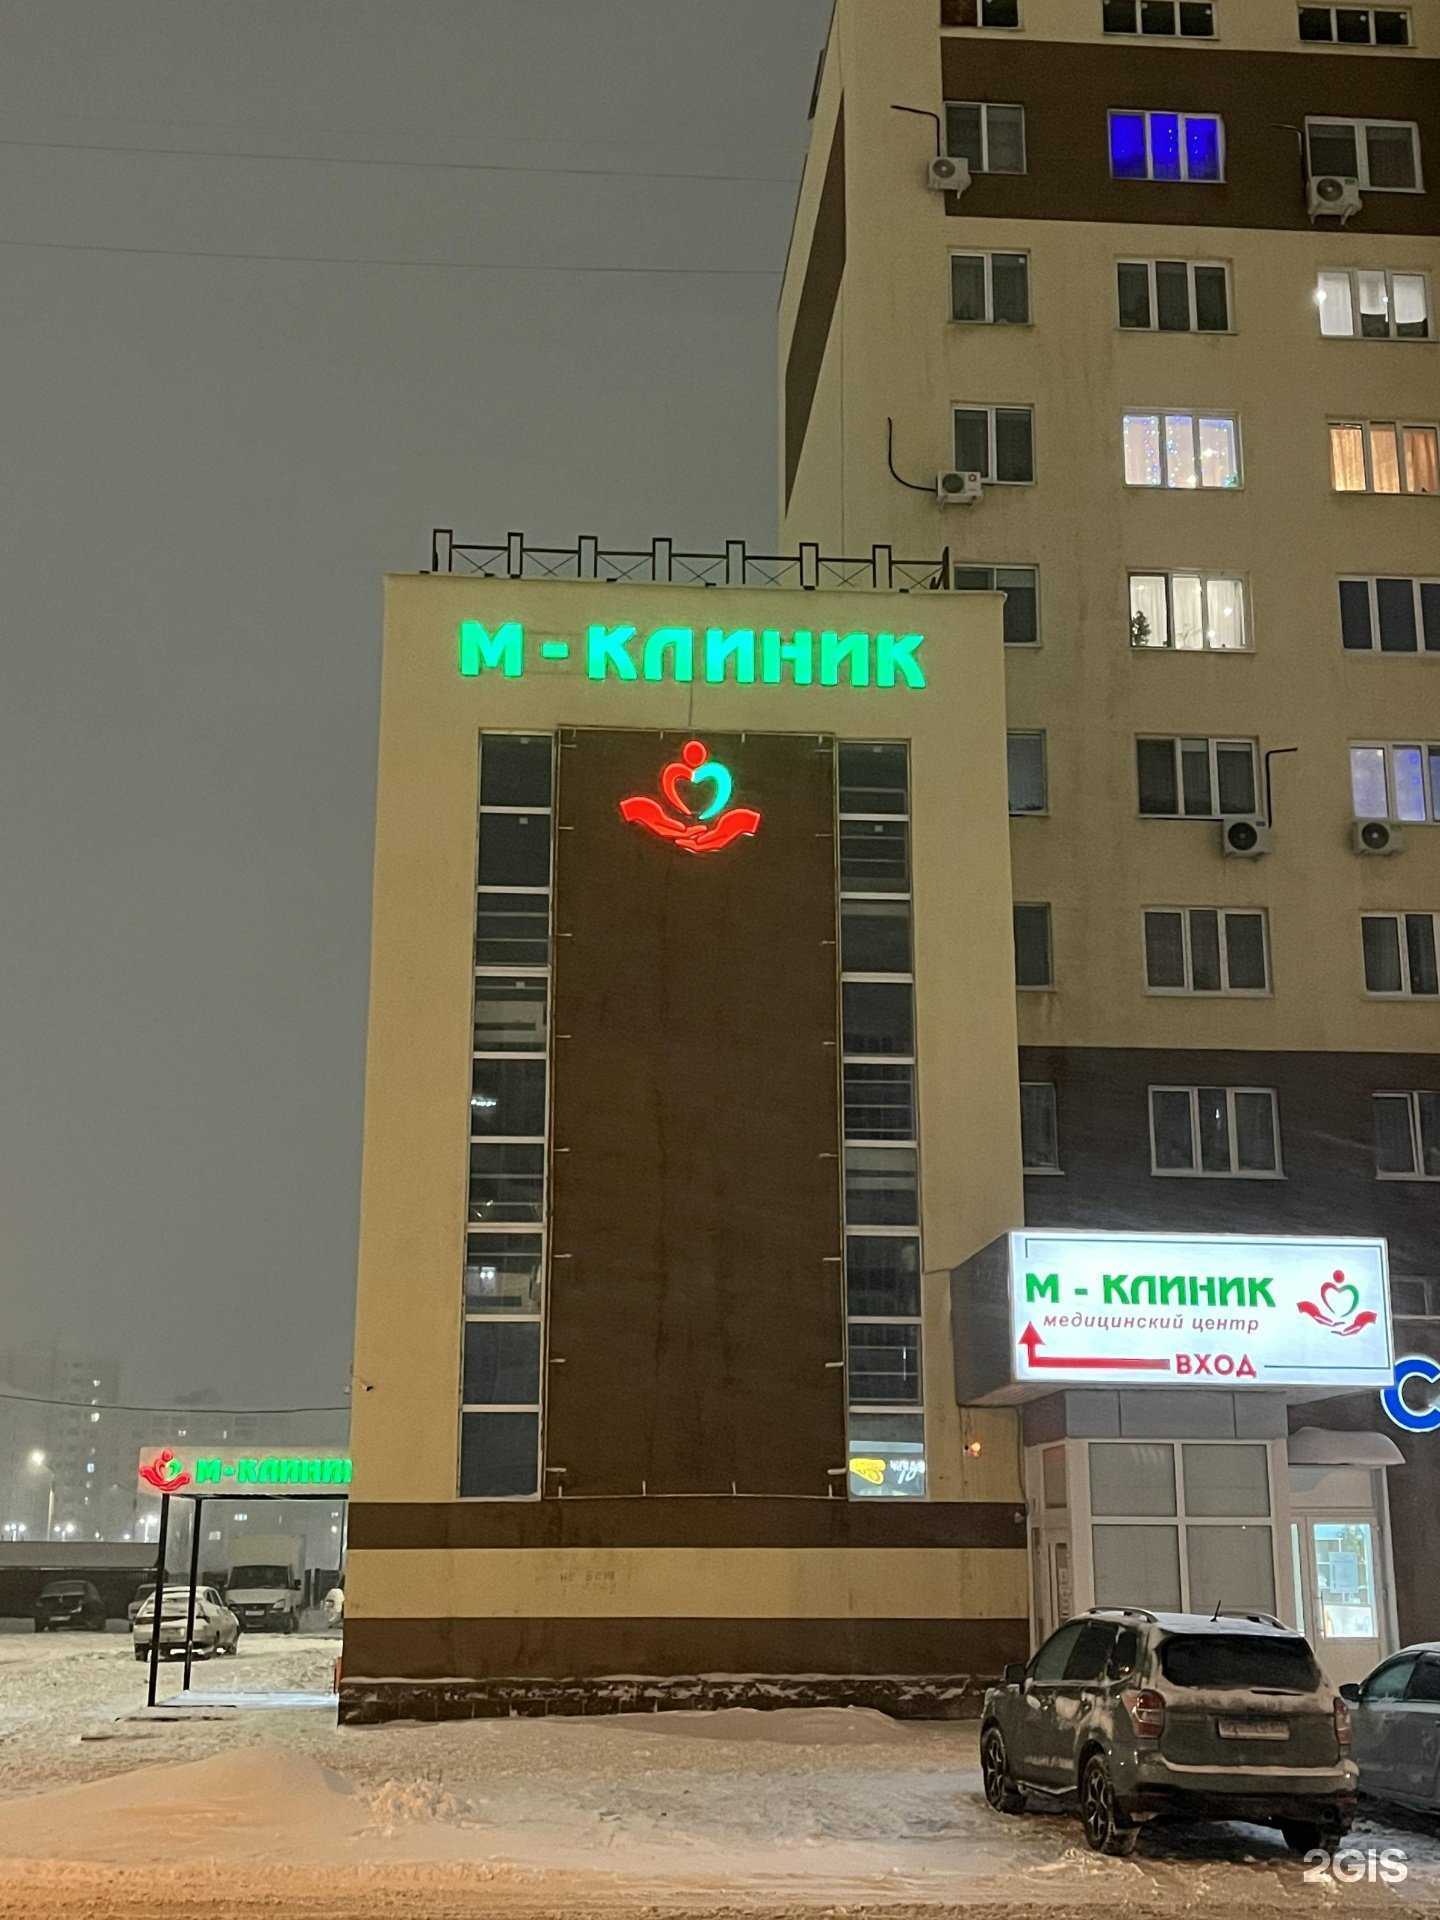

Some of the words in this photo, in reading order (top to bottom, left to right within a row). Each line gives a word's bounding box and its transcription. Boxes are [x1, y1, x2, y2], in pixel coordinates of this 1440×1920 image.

[588, 624, 926, 689] КЛИНИК
[1102, 1274, 1277, 1308] КЛИНИК
[1043, 1311, 1184, 1331] медицинский
[1191, 1315, 1259, 1334] центр
[1174, 1352, 1258, 1379] ВХОД
